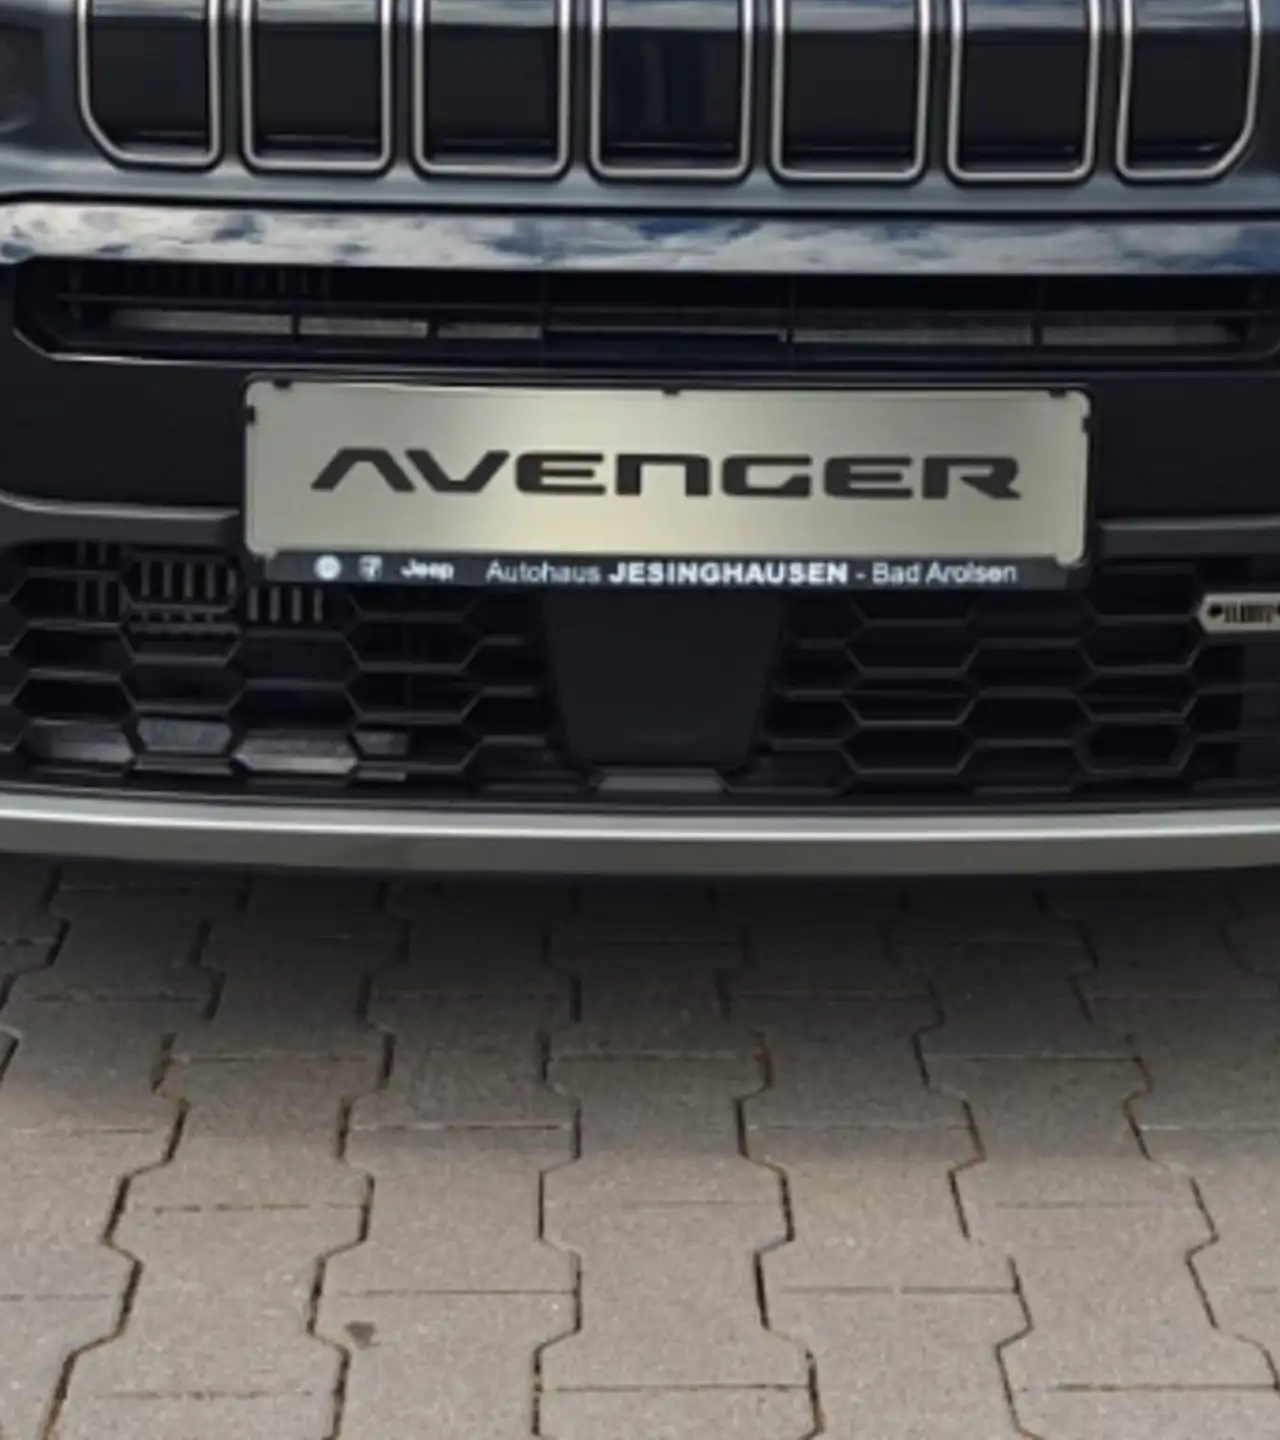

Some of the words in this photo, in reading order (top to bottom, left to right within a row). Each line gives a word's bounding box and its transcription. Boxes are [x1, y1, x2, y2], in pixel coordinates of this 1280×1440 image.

[310, 447, 1023, 500] AVENGER
[400, 558, 455, 582] Jeep
[484, 560, 601, 584] Autohaus
[608, 561, 849, 586] JESINGHAUSEN
[872, 563, 920, 585] Bad
[924, 562, 1017, 585] Arolsen
